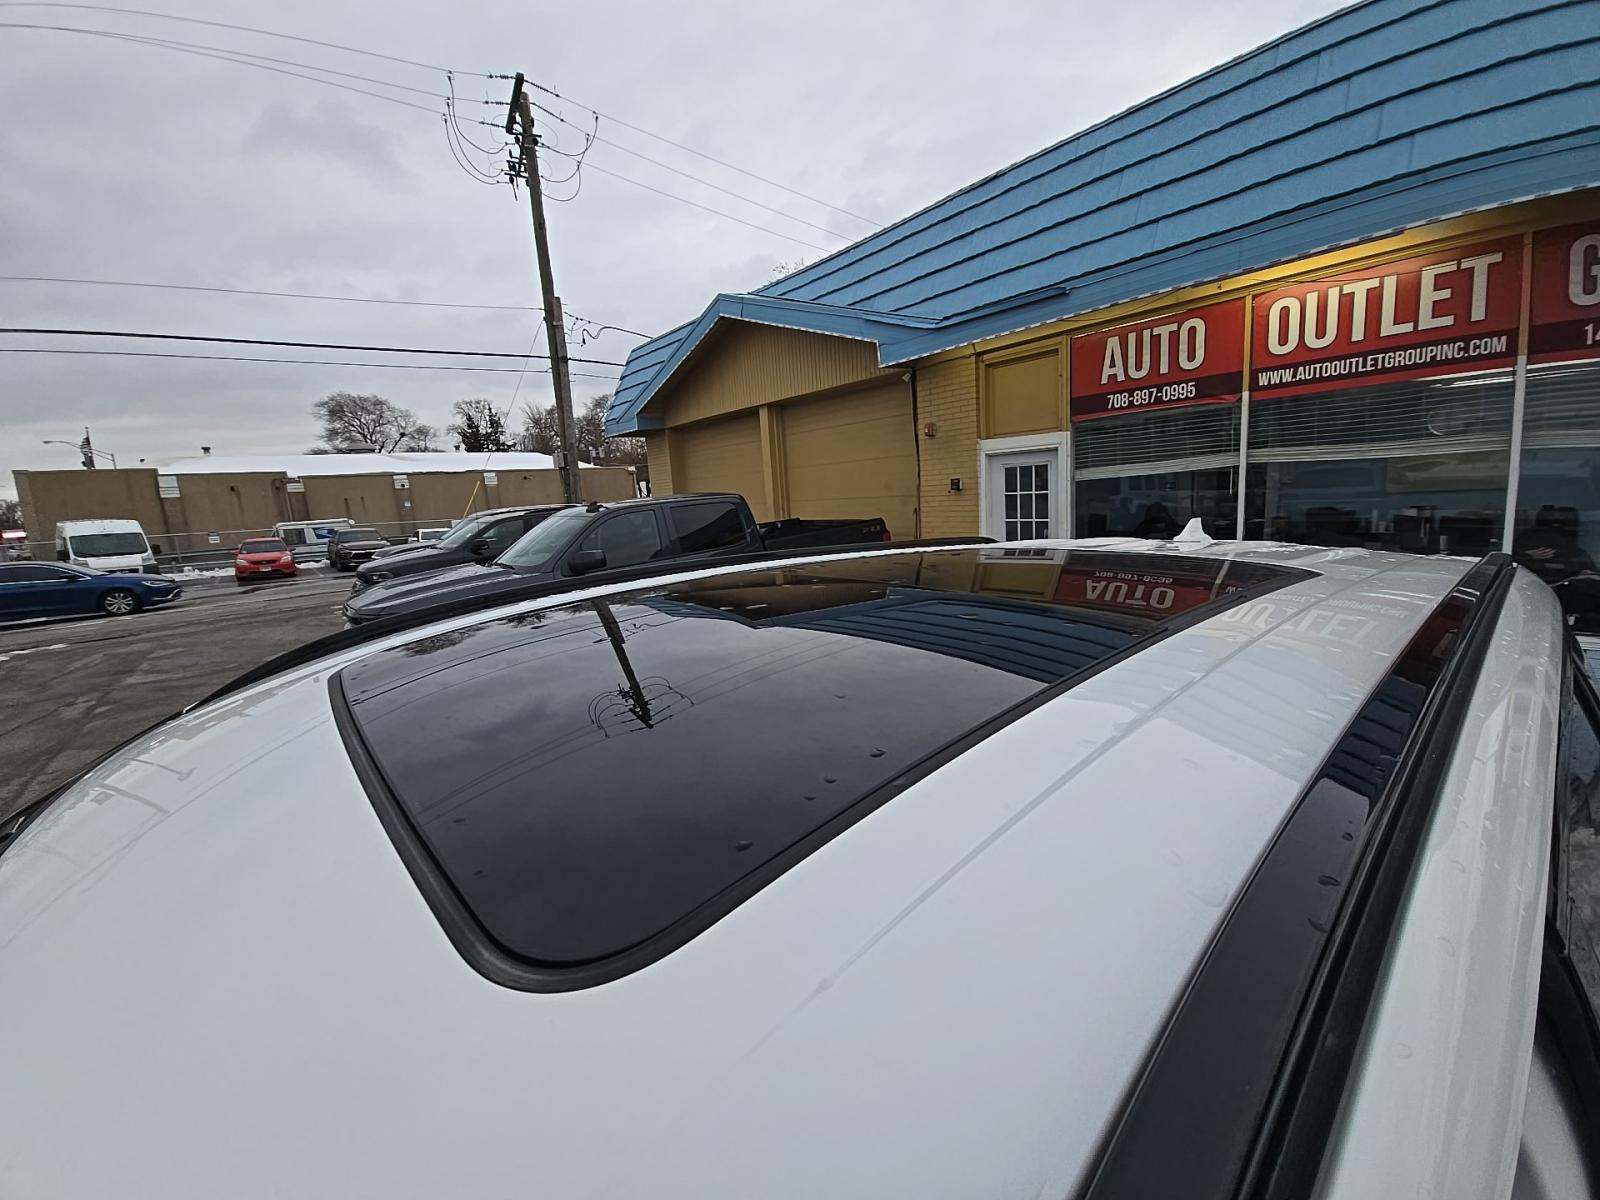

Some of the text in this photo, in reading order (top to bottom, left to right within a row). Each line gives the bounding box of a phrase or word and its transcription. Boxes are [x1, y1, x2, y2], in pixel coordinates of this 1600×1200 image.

[1101, 317, 1206, 385] AUTO
[1267, 252, 1503, 355] OUTLET
[1258, 335, 1508, 387] WWW.AUTOOUTLETGROUPINC.COM
[1107, 381, 1196, 409] 708-897-0995
